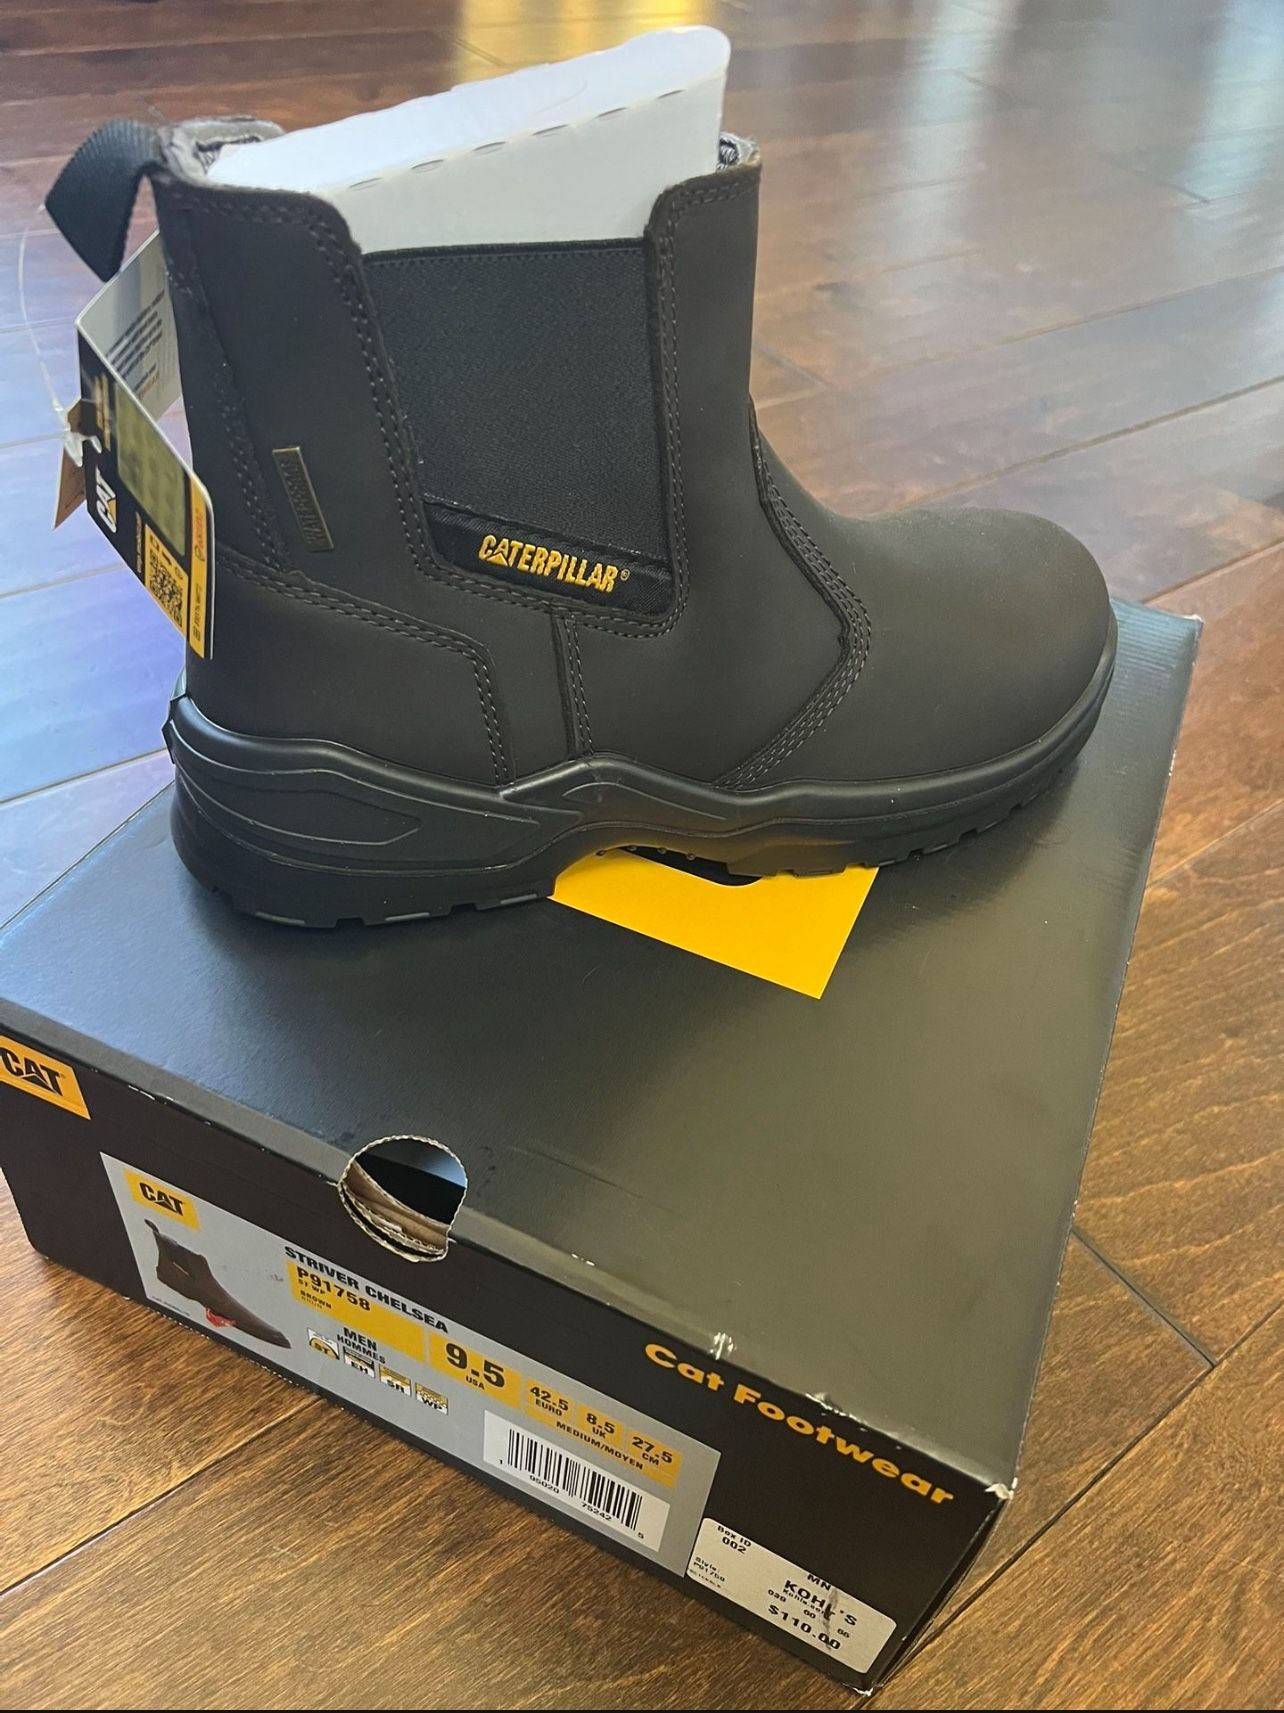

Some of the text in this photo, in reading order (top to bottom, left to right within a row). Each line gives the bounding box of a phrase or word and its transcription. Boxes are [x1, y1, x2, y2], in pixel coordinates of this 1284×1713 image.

[95, 464, 117, 533] CAT
[0, 1046, 64, 1097] CAT
[139, 1182, 184, 1217] CAT
[284, 1245, 449, 1334] STRIVER CHELSEA
[296, 1265, 371, 1312] P91758
[313, 1341, 331, 1356] ST
[337, 1333, 386, 1364] HOMMES
[343, 1326, 377, 1351] MEN
[351, 1360, 369, 1375] EH
[445, 1342, 505, 1389] 9.5
[465, 1375, 486, 1391] USA
[421, 1396, 443, 1411] WP
[529, 1385, 569, 1412] 42.5
[535, 1399, 563, 1417] EURO
[586, 1412, 616, 1435] 8.5
[592, 1426, 607, 1439] UK
[645, 1343, 955, 1504] Cat Footwear
[556, 1420, 644, 1471] MEDIUM/MOYEN
[631, 1436, 673, 1464] 27.5
[641, 1452, 660, 1466] CM
[581, 1501, 613, 1522] 75242
[717, 1525, 752, 1548] Box ID
[722, 1536, 747, 1555] 002
[807, 1573, 832, 1591] MN
[767, 1603, 842, 1650] $110.00
